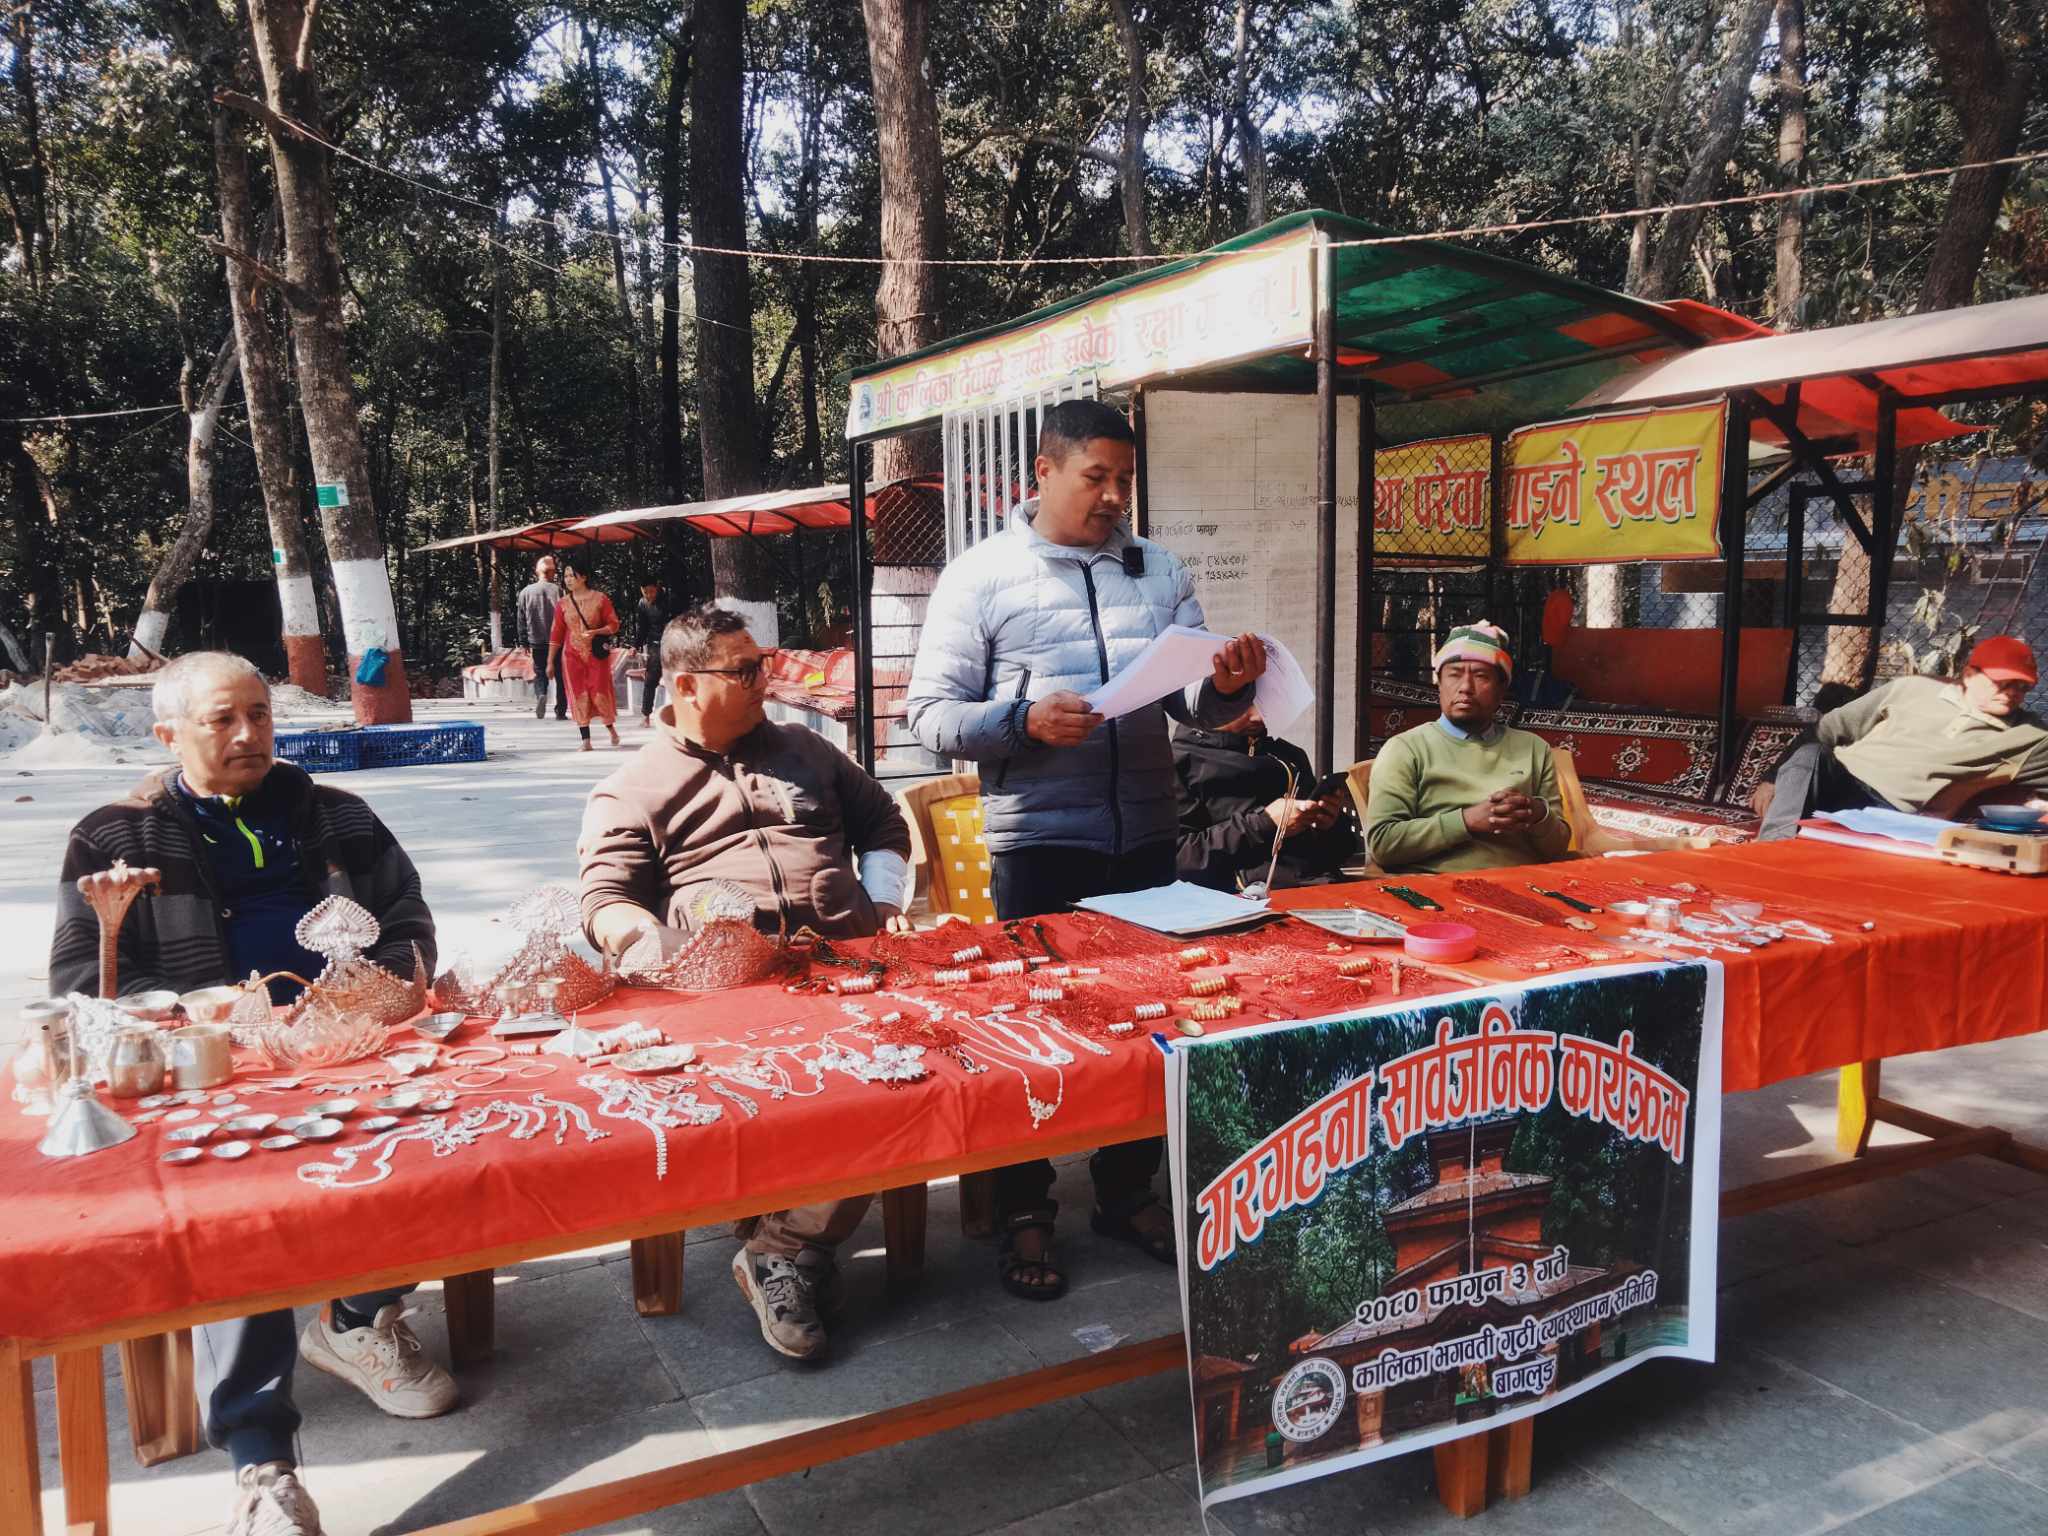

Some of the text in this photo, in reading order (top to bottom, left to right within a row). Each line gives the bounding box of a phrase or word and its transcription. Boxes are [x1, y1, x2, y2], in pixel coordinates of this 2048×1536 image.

[1593, 444, 1703, 528] स्थल
[1197, 1001, 1689, 1271] गरगहना सार्वजनिक कार्यक्रम
[1352, 1270, 1659, 1392] कालिका भगवती गुठी व्यवस्थापन समिति
[1356, 1245, 1570, 1325] २०८० फागुन ३ गते
